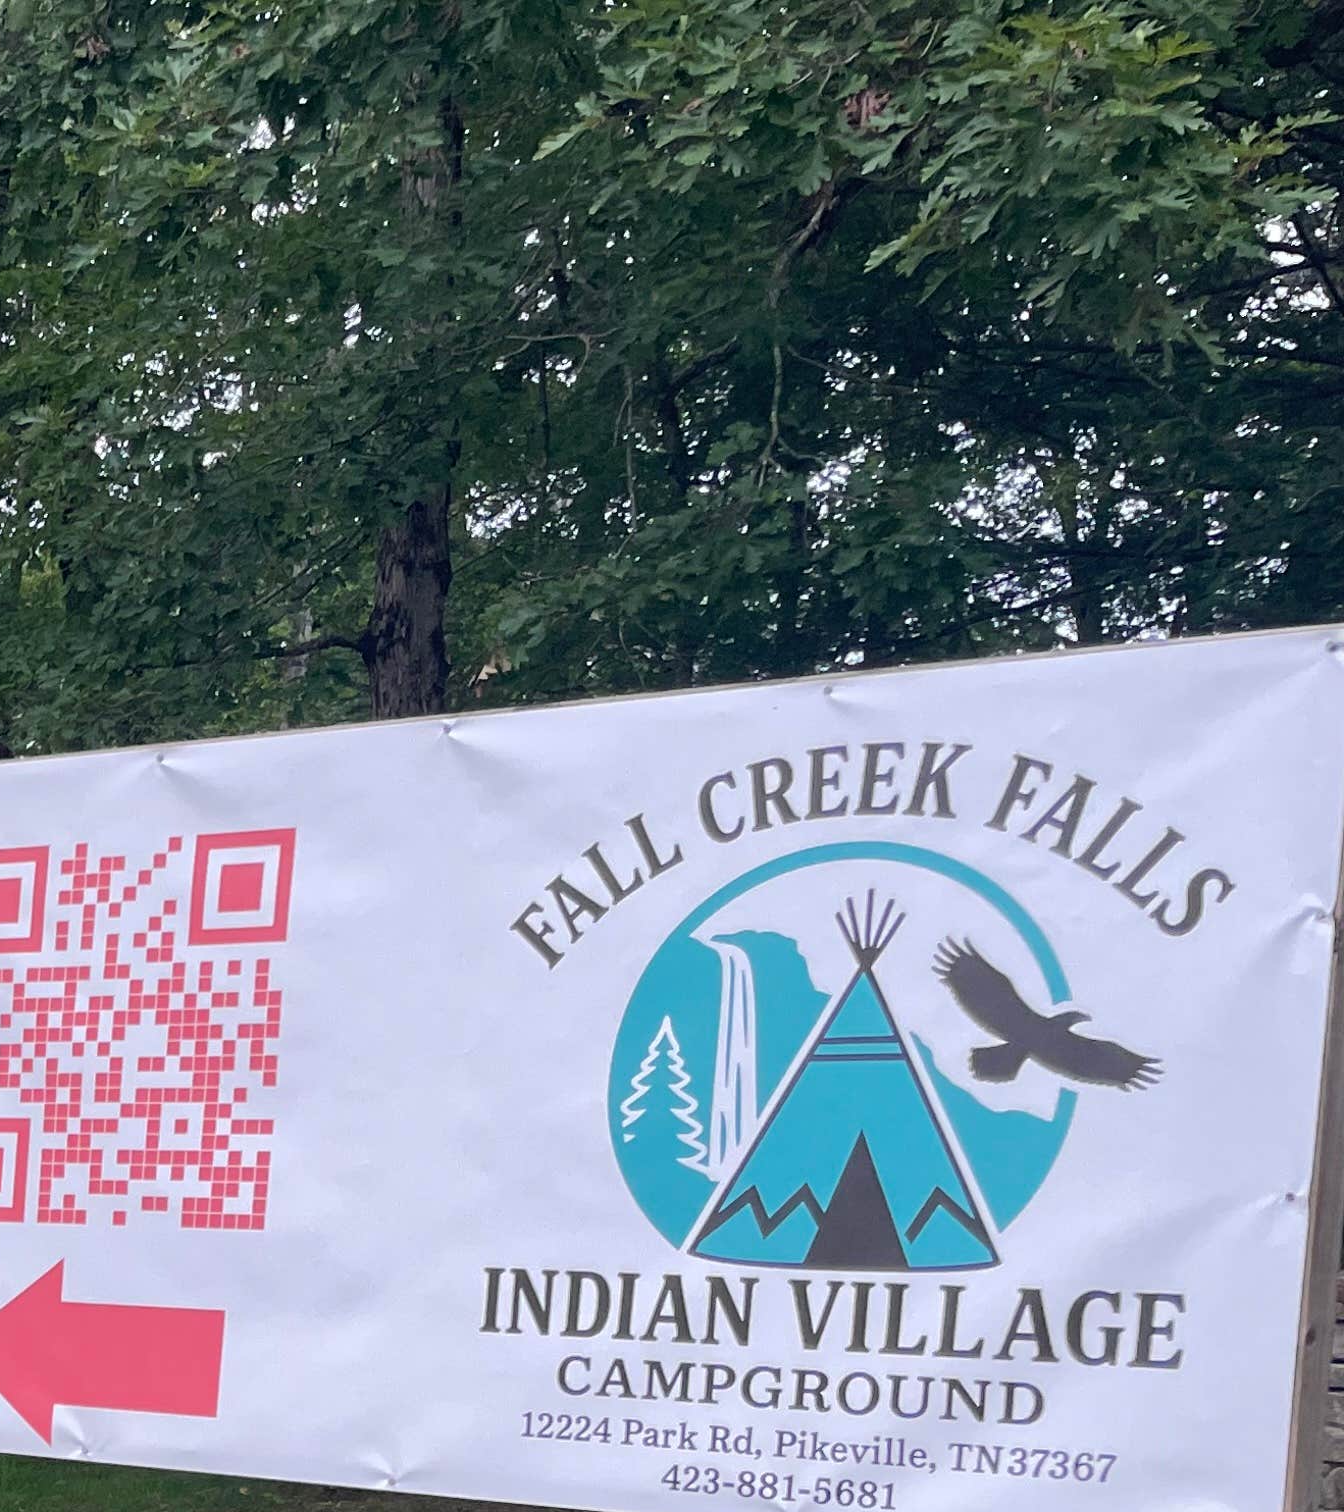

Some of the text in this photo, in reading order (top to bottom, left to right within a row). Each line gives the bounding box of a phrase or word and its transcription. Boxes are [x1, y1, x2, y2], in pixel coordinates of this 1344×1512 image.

[509, 741, 1236, 970] FALL CREEK FALLS
[480, 1266, 1185, 1370] INDIAN VILLAGE
[557, 1354, 1045, 1426] CAMPGROUND
[520, 1411, 612, 1444] 12224
[620, 1418, 699, 1452] Park
[707, 1424, 762, 1460] Rd,
[772, 1429, 937, 1474] Pikeville,
[660, 1463, 897, 1511] 423-881-5681
